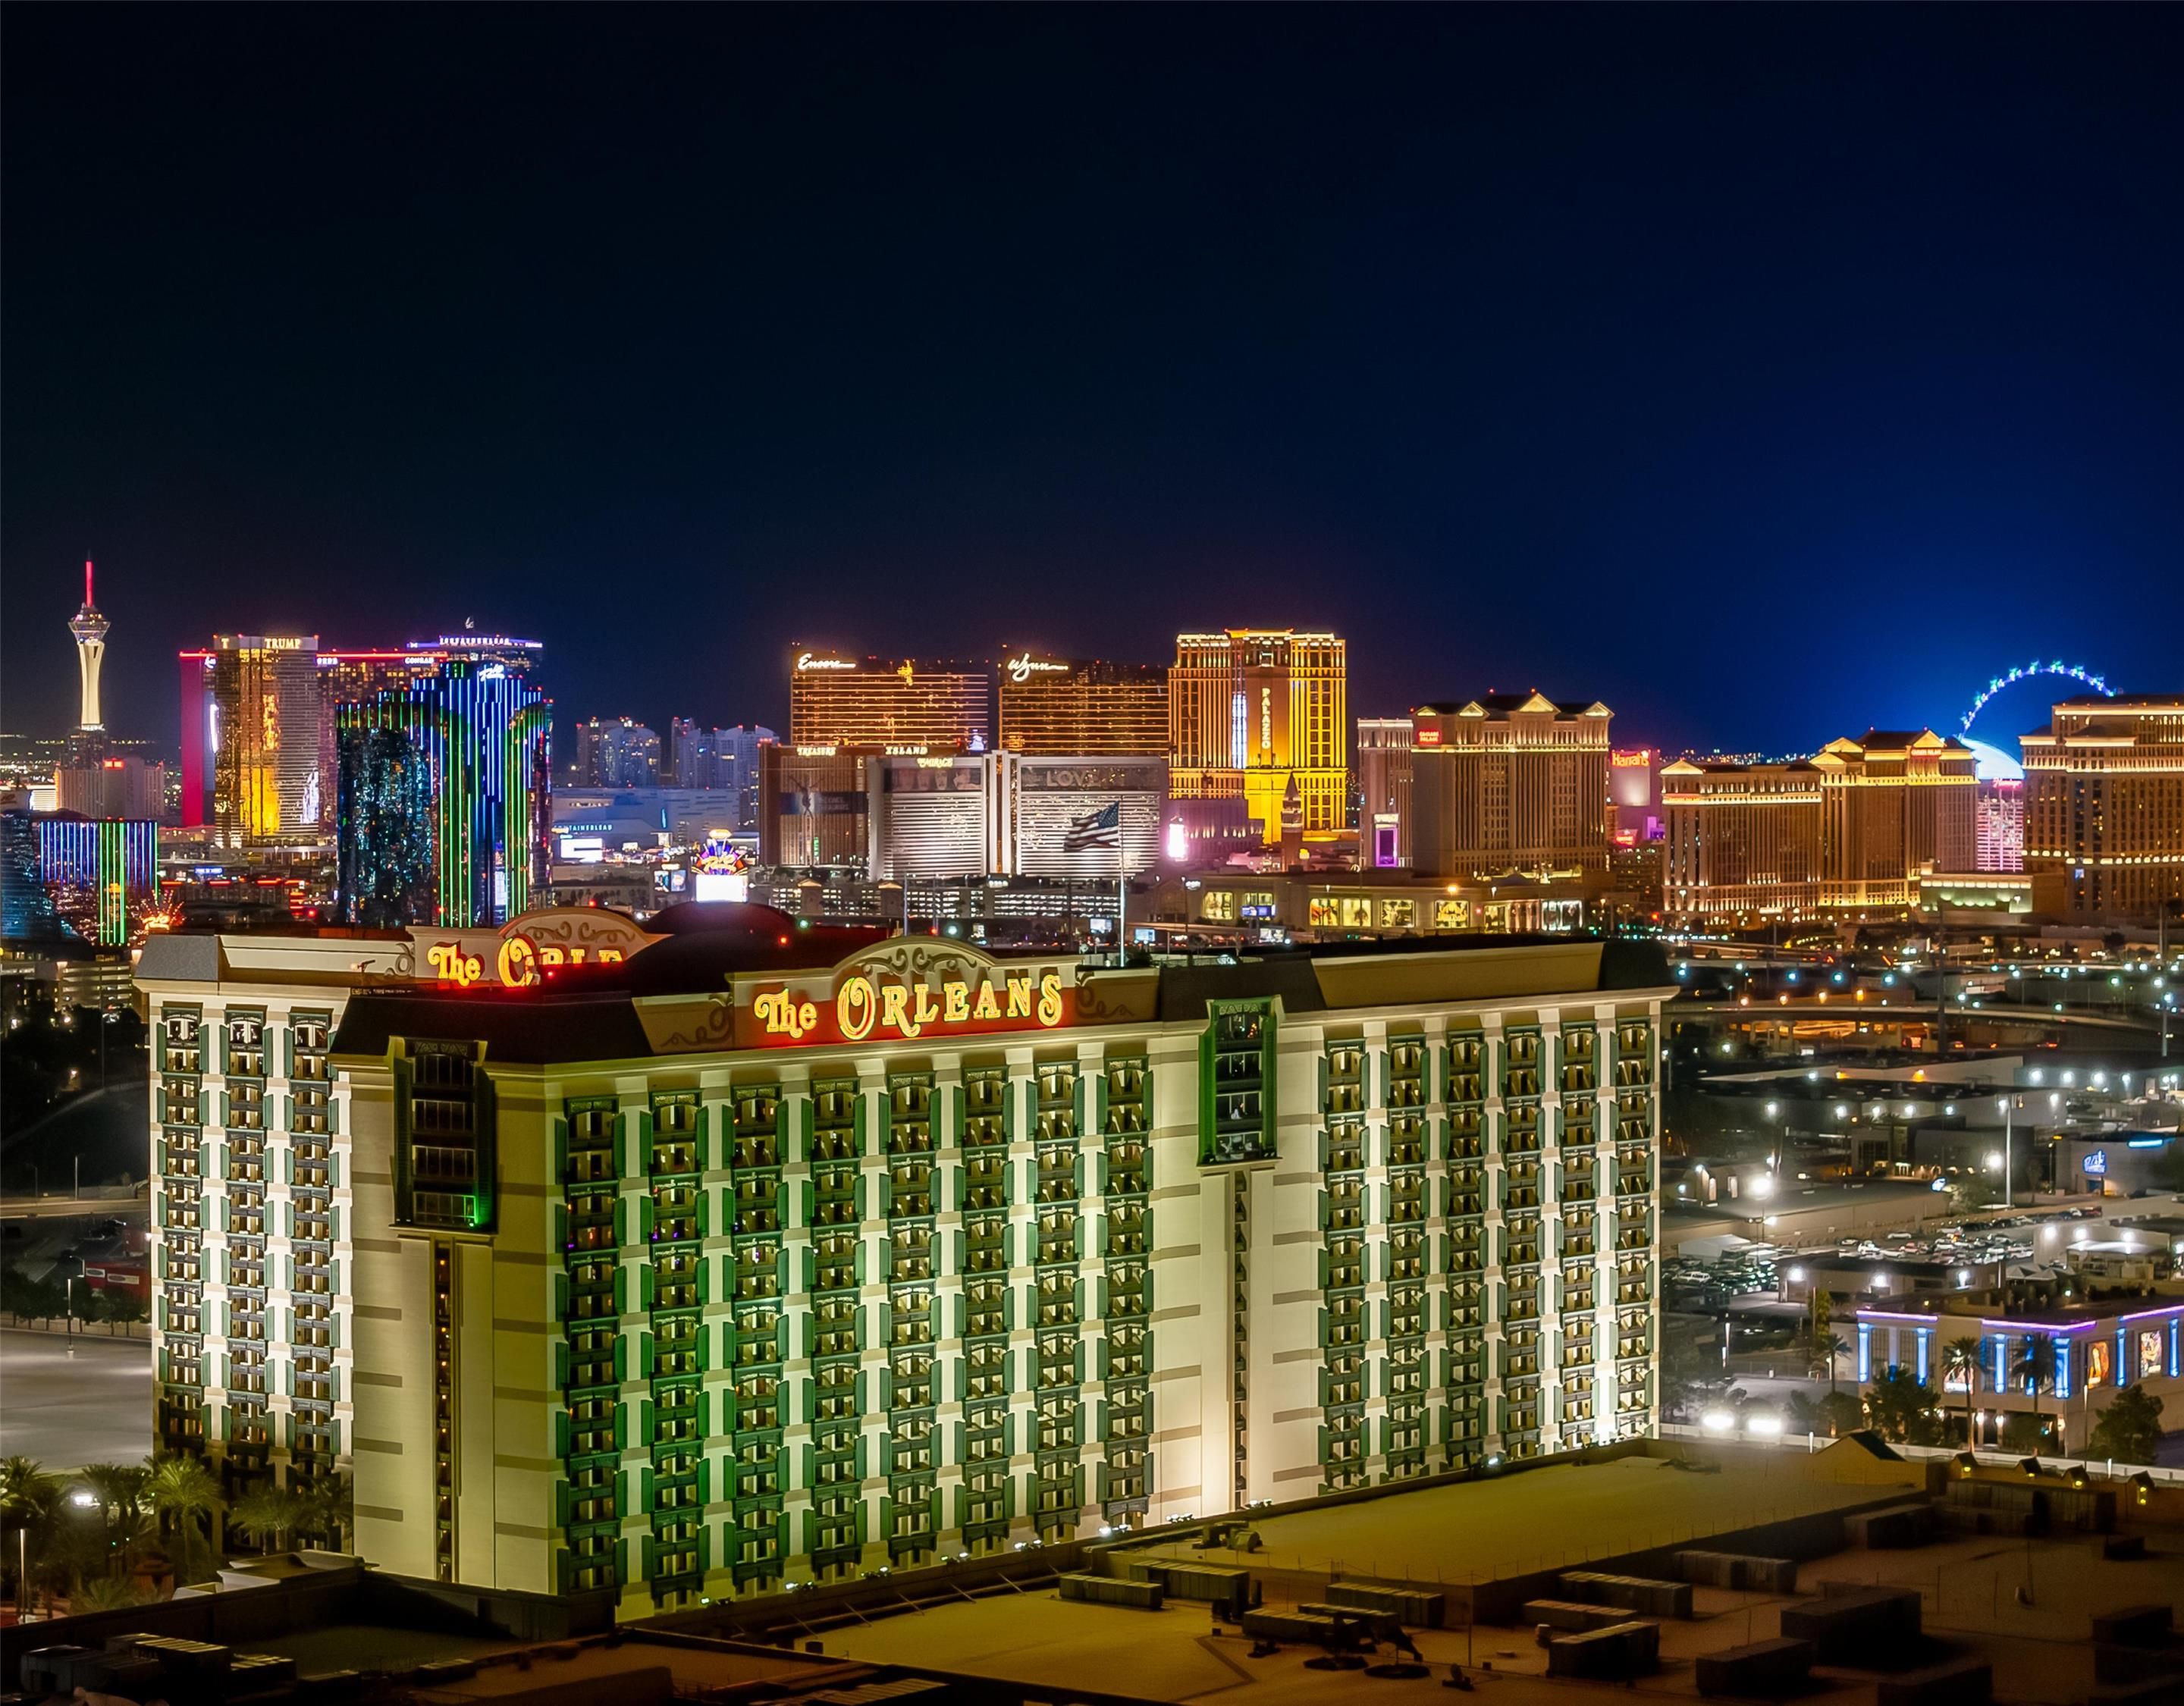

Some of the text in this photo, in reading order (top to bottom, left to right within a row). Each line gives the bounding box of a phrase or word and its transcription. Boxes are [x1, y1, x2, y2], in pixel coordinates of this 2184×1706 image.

[265, 638, 300, 649] TRUMP
[798, 654, 855, 670] Encore
[1262, 688, 1271, 749] PALAZZO
[797, 746, 928, 757] TREASURE ISLAND
[427, 942, 482, 987] The
[754, 974, 1063, 1040] The ORLEANS
